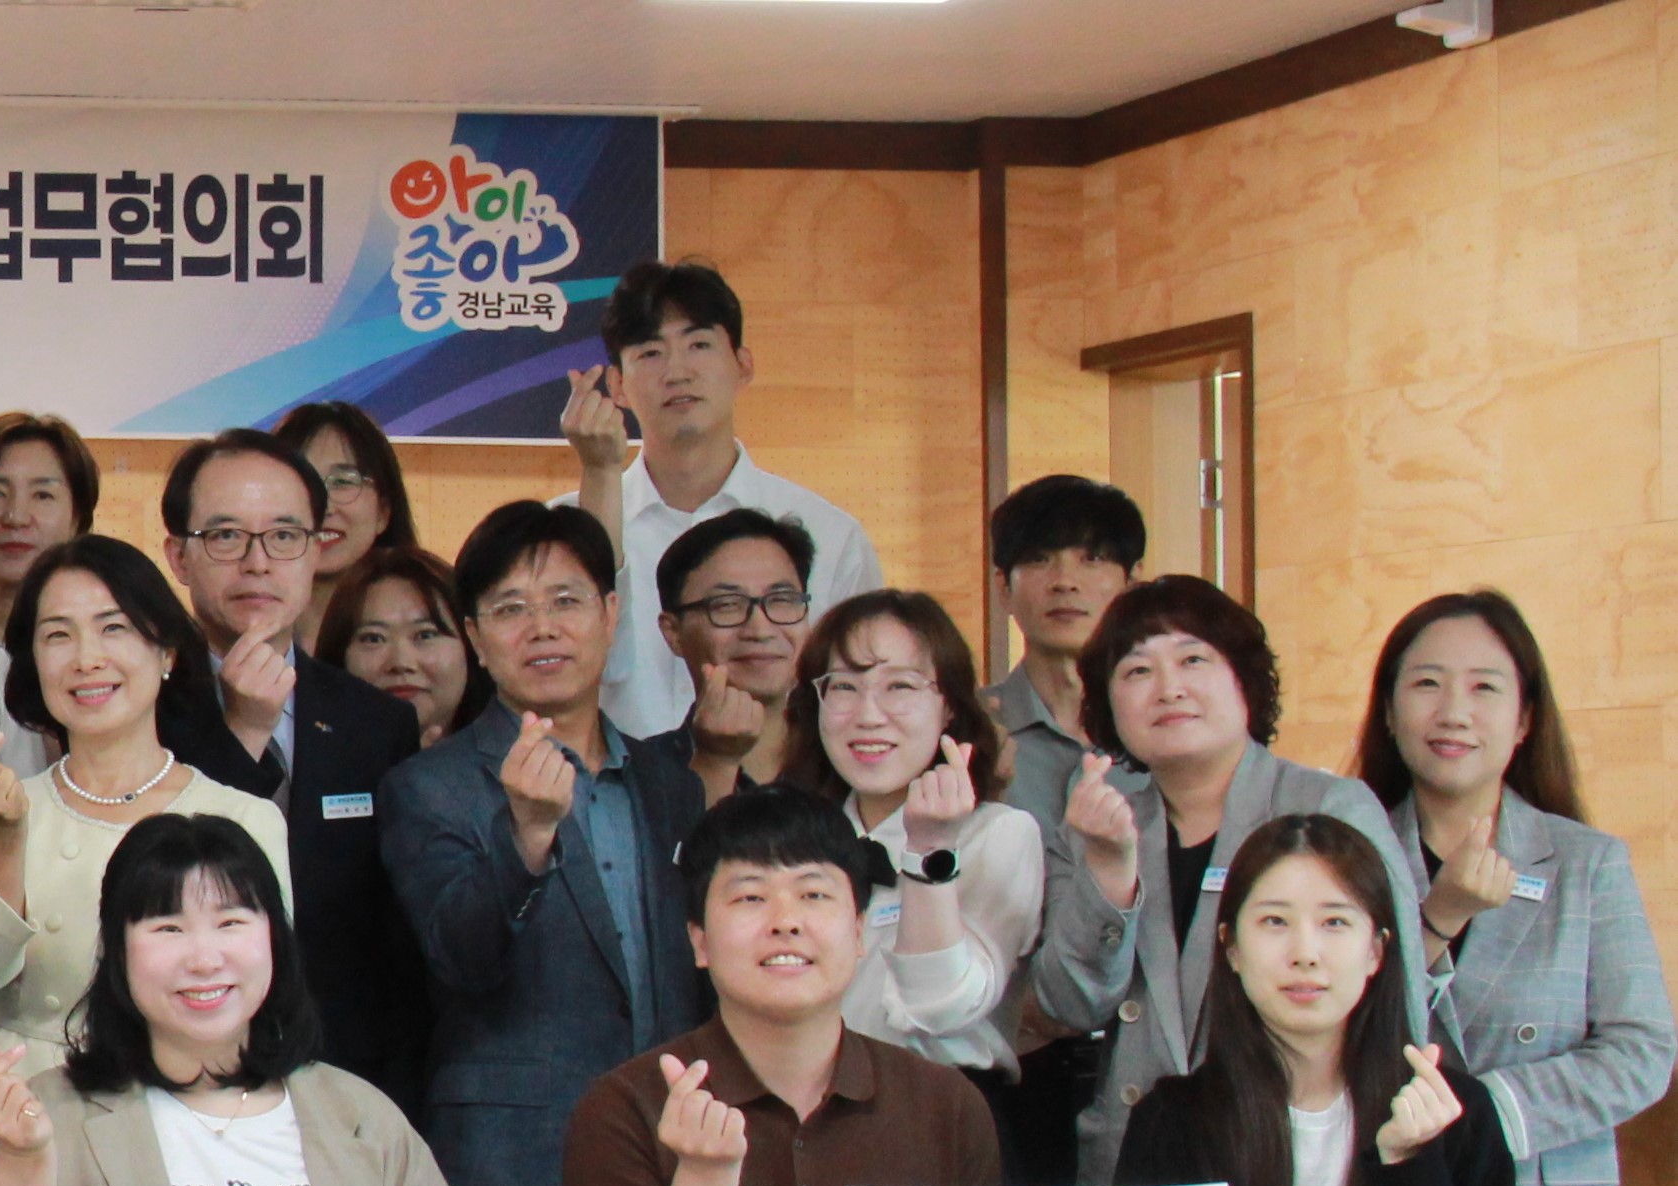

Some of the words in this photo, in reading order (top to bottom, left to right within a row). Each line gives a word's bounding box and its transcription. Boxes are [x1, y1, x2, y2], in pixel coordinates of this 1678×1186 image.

[390, 155, 527, 224] 아이
[402, 218, 570, 320] 좋아
[456, 290, 557, 321] 경남교육
